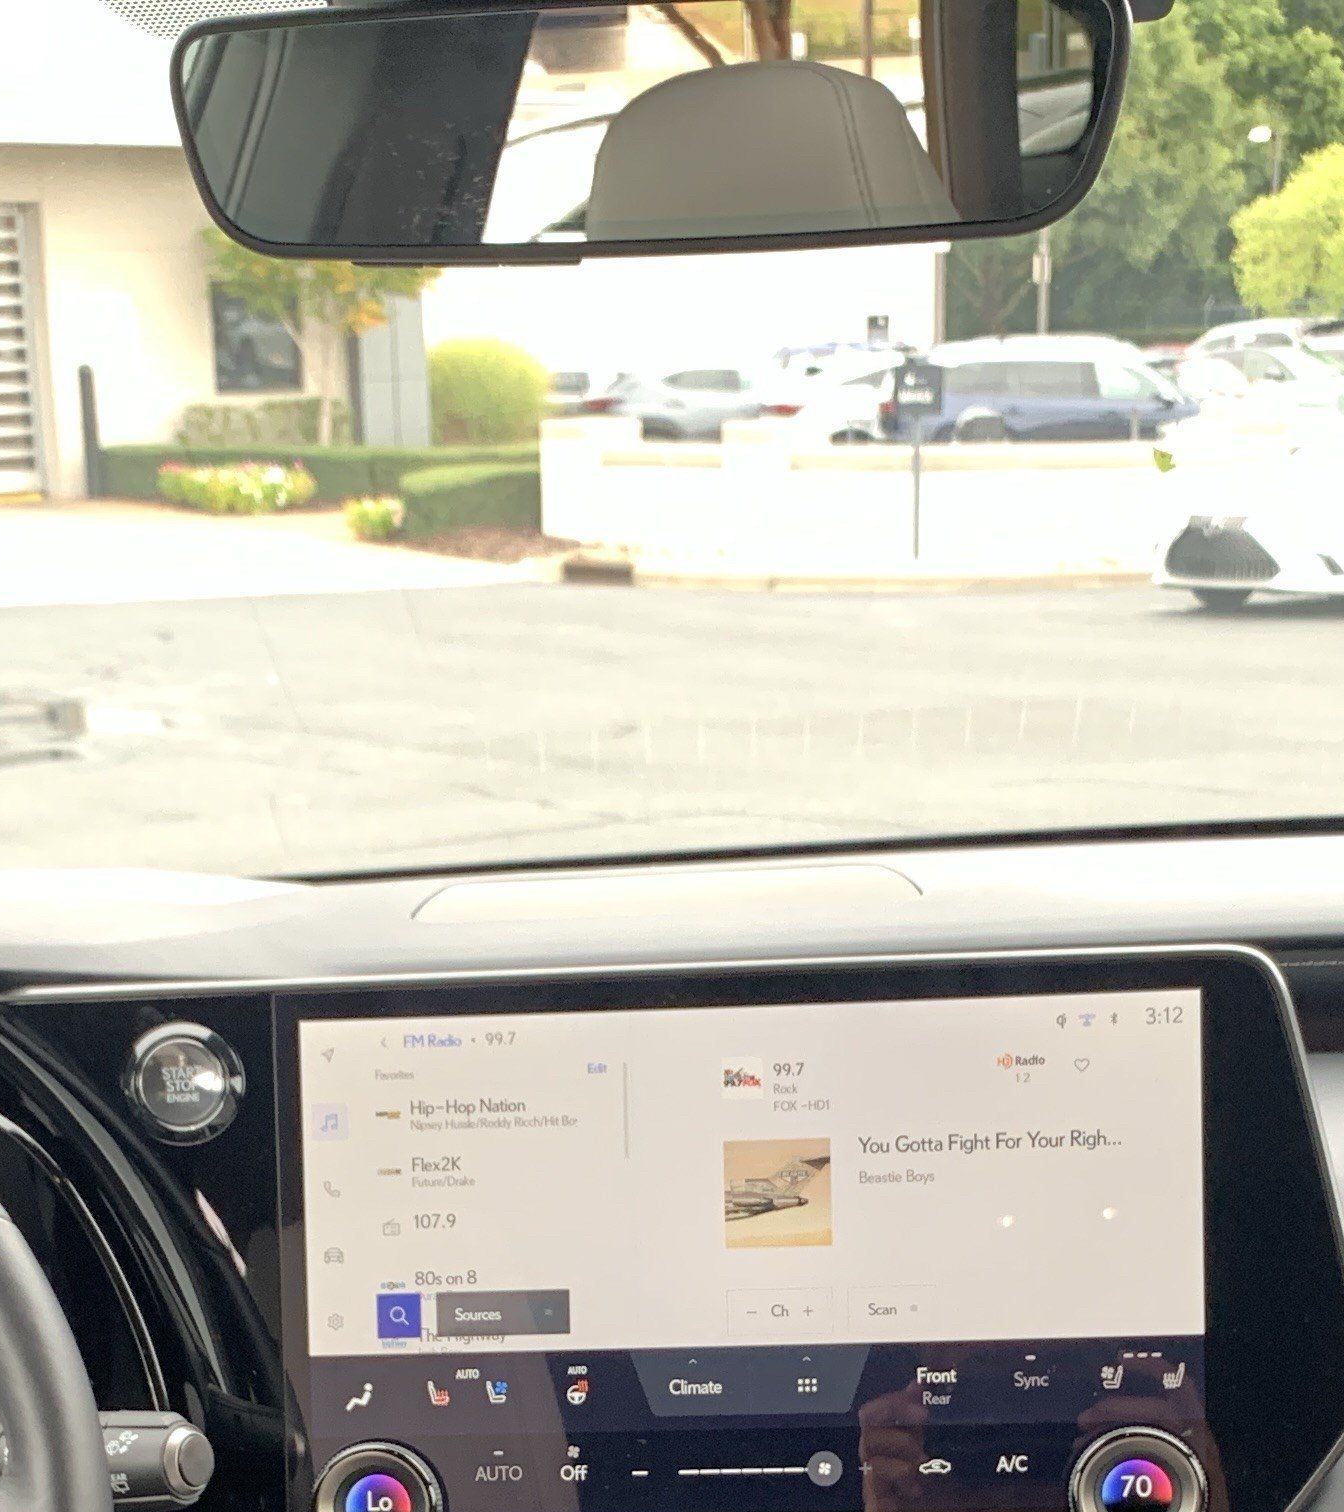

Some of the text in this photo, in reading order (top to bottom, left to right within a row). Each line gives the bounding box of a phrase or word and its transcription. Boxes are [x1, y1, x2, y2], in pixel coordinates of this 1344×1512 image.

[1145, 1006, 1184, 1025] 3:12
[403, 1031, 516, 1048] FM Radio 99.7
[1015, 1054, 1045, 1067] Radio
[161, 1065, 202, 1080] START
[374, 1068, 414, 1080] Favorites
[586, 1062, 607, 1075] Edit
[772, 1062, 805, 1077] 99.7
[773, 1083, 798, 1094] Rock
[166, 1092, 201, 1104] ENGINE
[409, 1098, 476, 1117] Hip-Hop
[479, 1097, 526, 1114] Nation
[773, 1100, 797, 1112] FOX
[858, 1129, 1122, 1154] You Gotta Fight For Your Righ...
[411, 1156, 461, 1173] Flex2K
[411, 1174, 476, 1188] Future/Drake
[858, 1169, 935, 1184] Beastie Boys
[413, 1212, 457, 1230] 107.9
[414, 1270, 443, 1286] 80s
[445, 1274, 463, 1286] on
[466, 1269, 477, 1284] 8
[455, 1307, 502, 1321] Sources
[770, 1303, 790, 1318] Ch
[867, 1302, 897, 1316] Scan
[455, 1368, 480, 1380] AUTO
[567, 1365, 588, 1375] AUTO
[915, 1366, 957, 1384] Front
[668, 1378, 723, 1396] Climate
[1013, 1371, 1049, 1390] Sync
[922, 1390, 951, 1405] Rear
[995, 1454, 1029, 1473] A/C
[474, 1464, 523, 1482] AUTO
[559, 1463, 589, 1482] Off
[1120, 1475, 1152, 1499] 70
[366, 1489, 393, 1512] Lo
